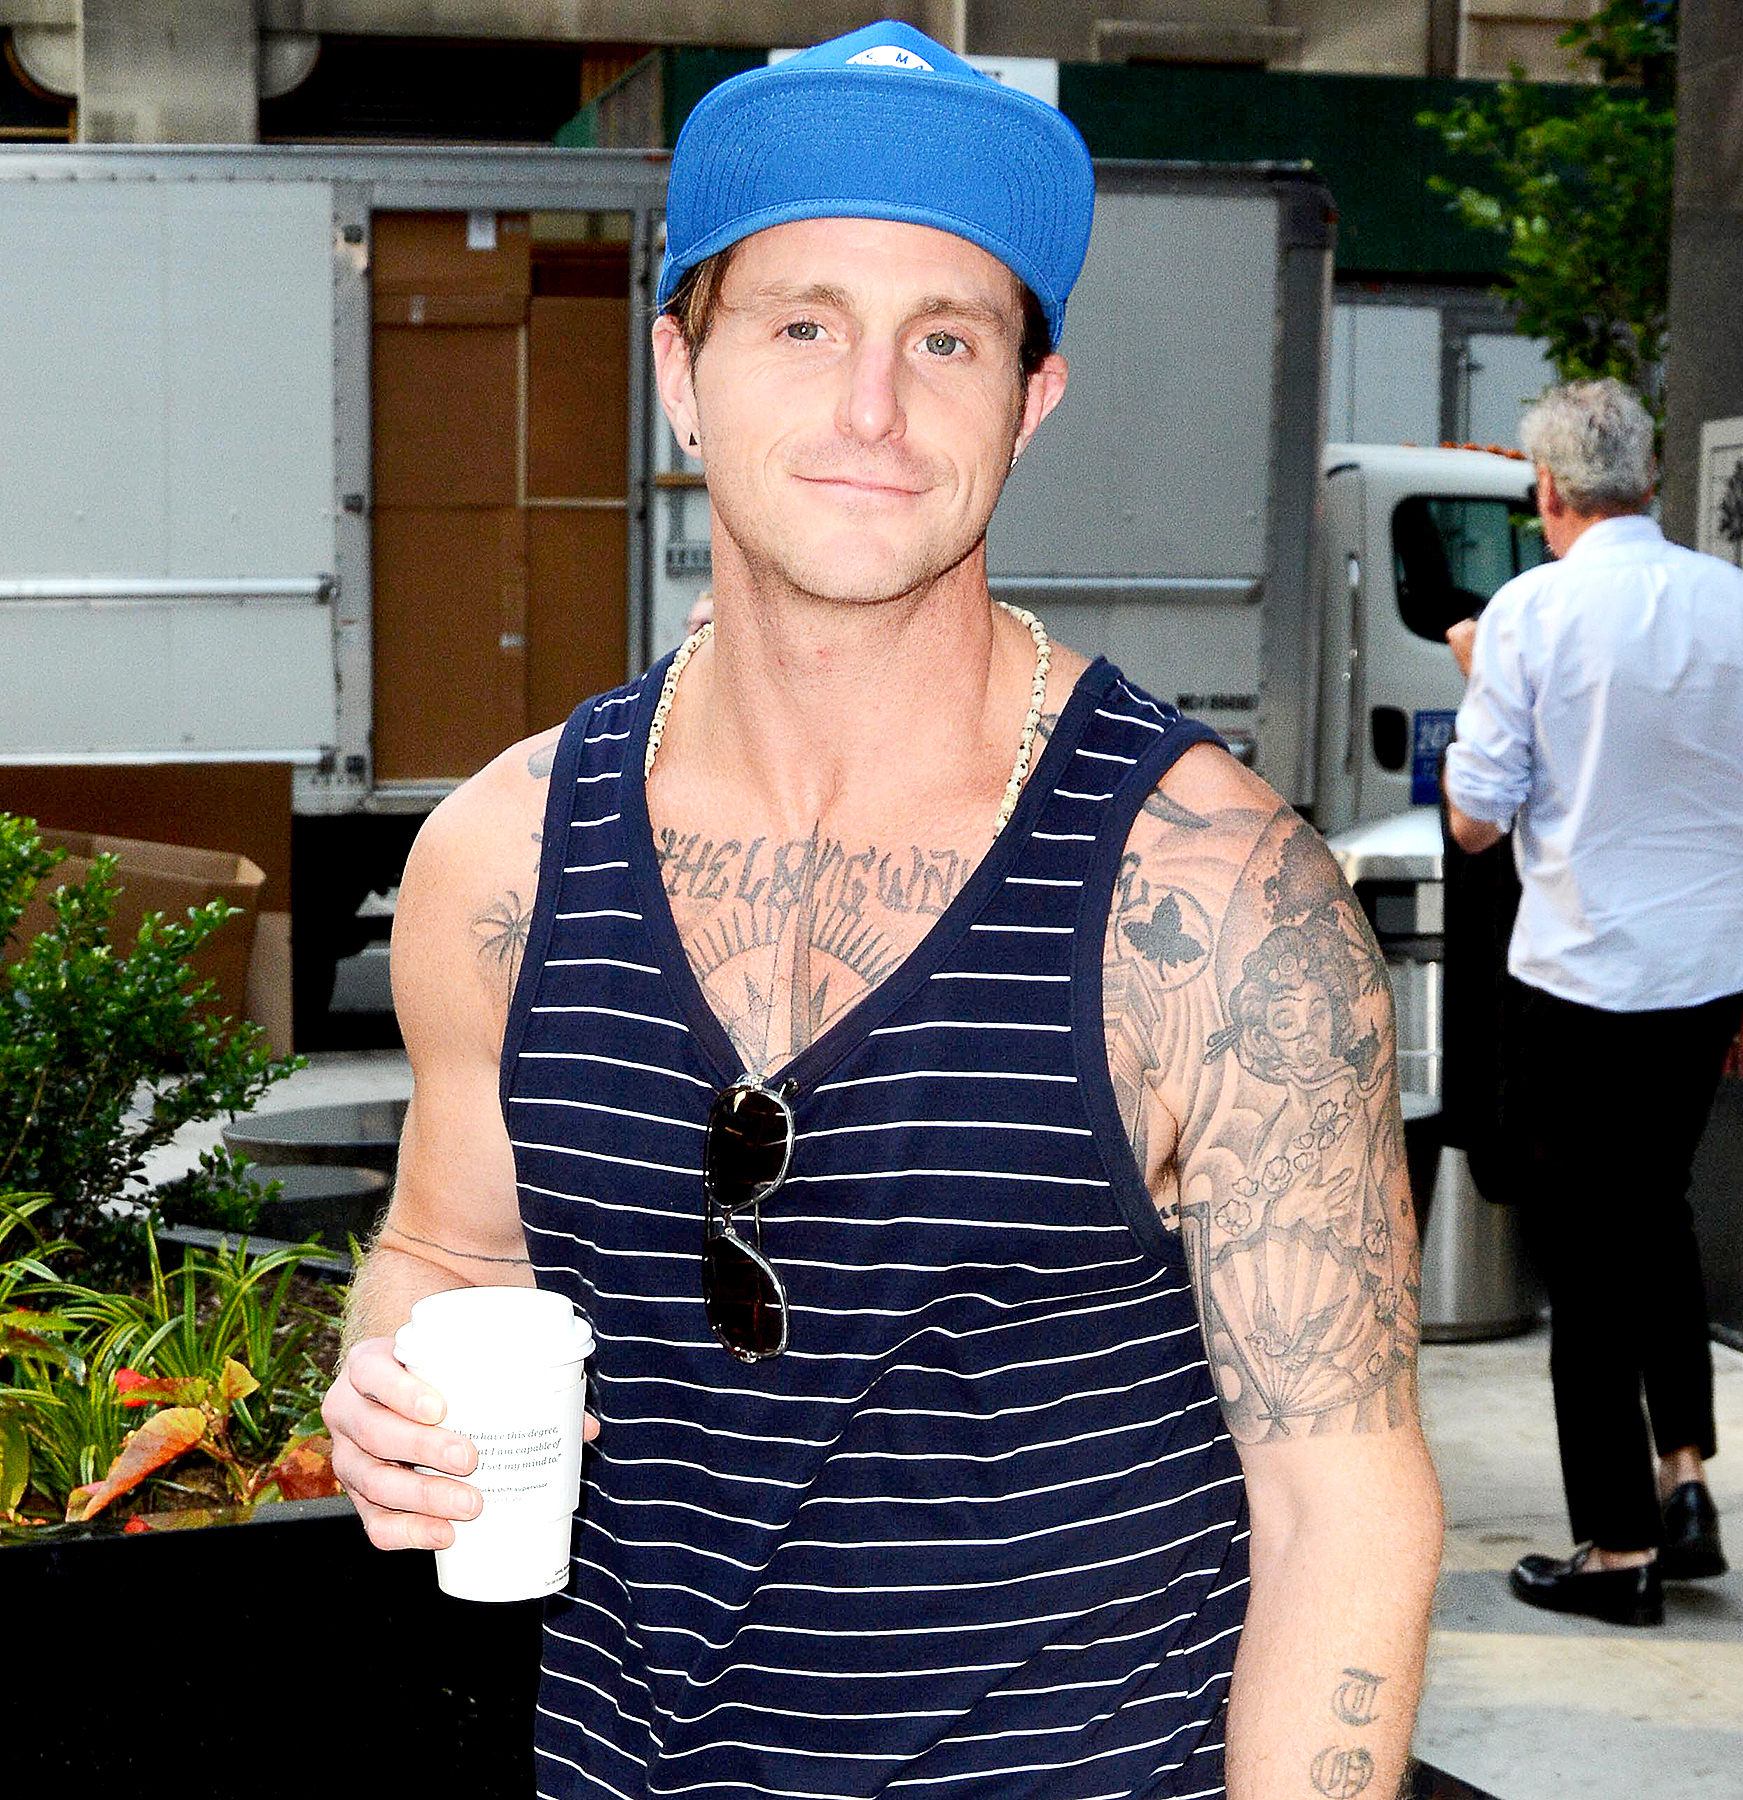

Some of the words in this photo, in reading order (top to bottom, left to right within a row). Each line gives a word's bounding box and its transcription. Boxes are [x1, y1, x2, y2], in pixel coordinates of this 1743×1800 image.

[480, 1432, 505, 1440] have
[507, 1430, 527, 1440] this
[497, 1448, 514, 1456] am
[515, 1442, 552, 1454] capable
[552, 1437, 562, 1449] of
[486, 1463, 502, 1471] set
[504, 1463, 521, 1471] my
[522, 1456, 547, 1468] mind
